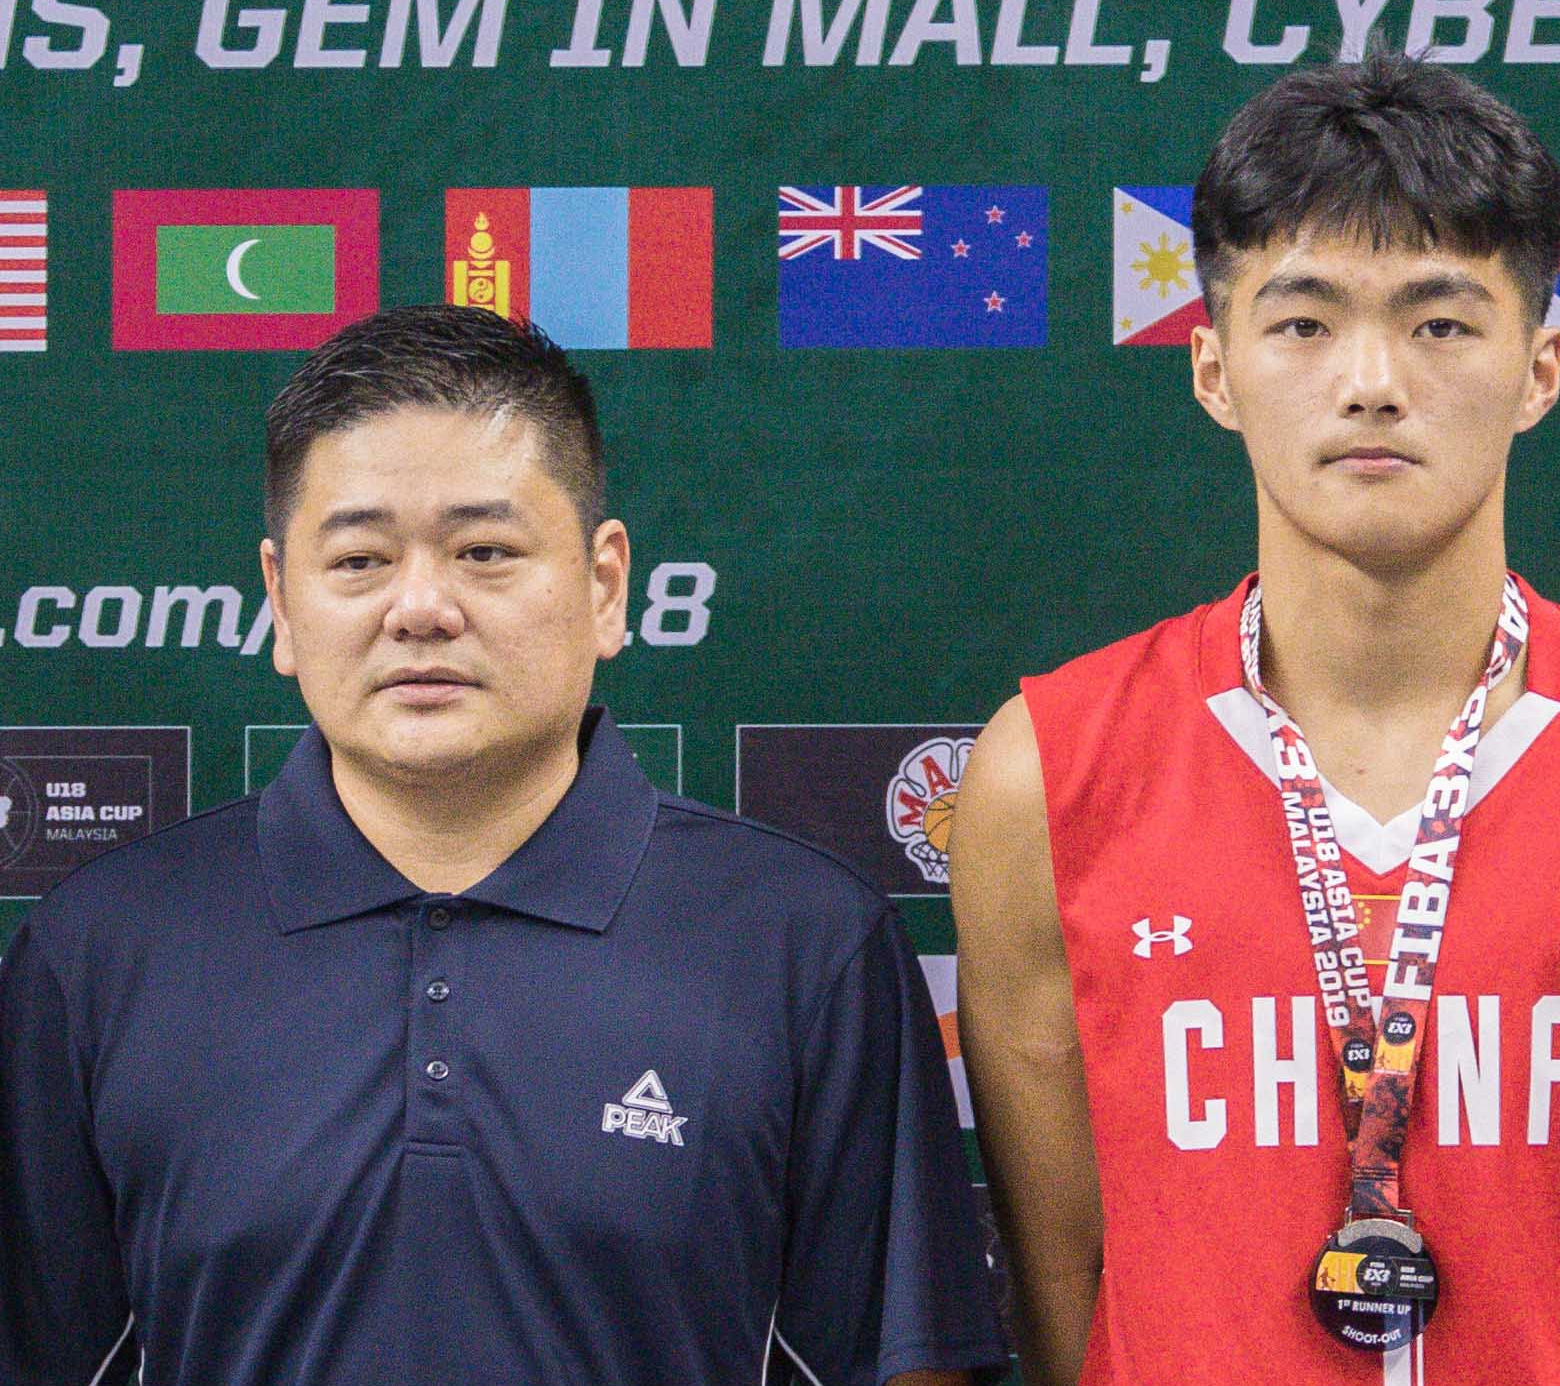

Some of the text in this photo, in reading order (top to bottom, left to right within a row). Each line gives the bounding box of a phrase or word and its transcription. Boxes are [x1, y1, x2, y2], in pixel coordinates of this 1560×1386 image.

[46, 783, 86, 797] U18
[46, 806, 142, 820] ASIA CUP
[601, 1103, 687, 1146] PEAK
